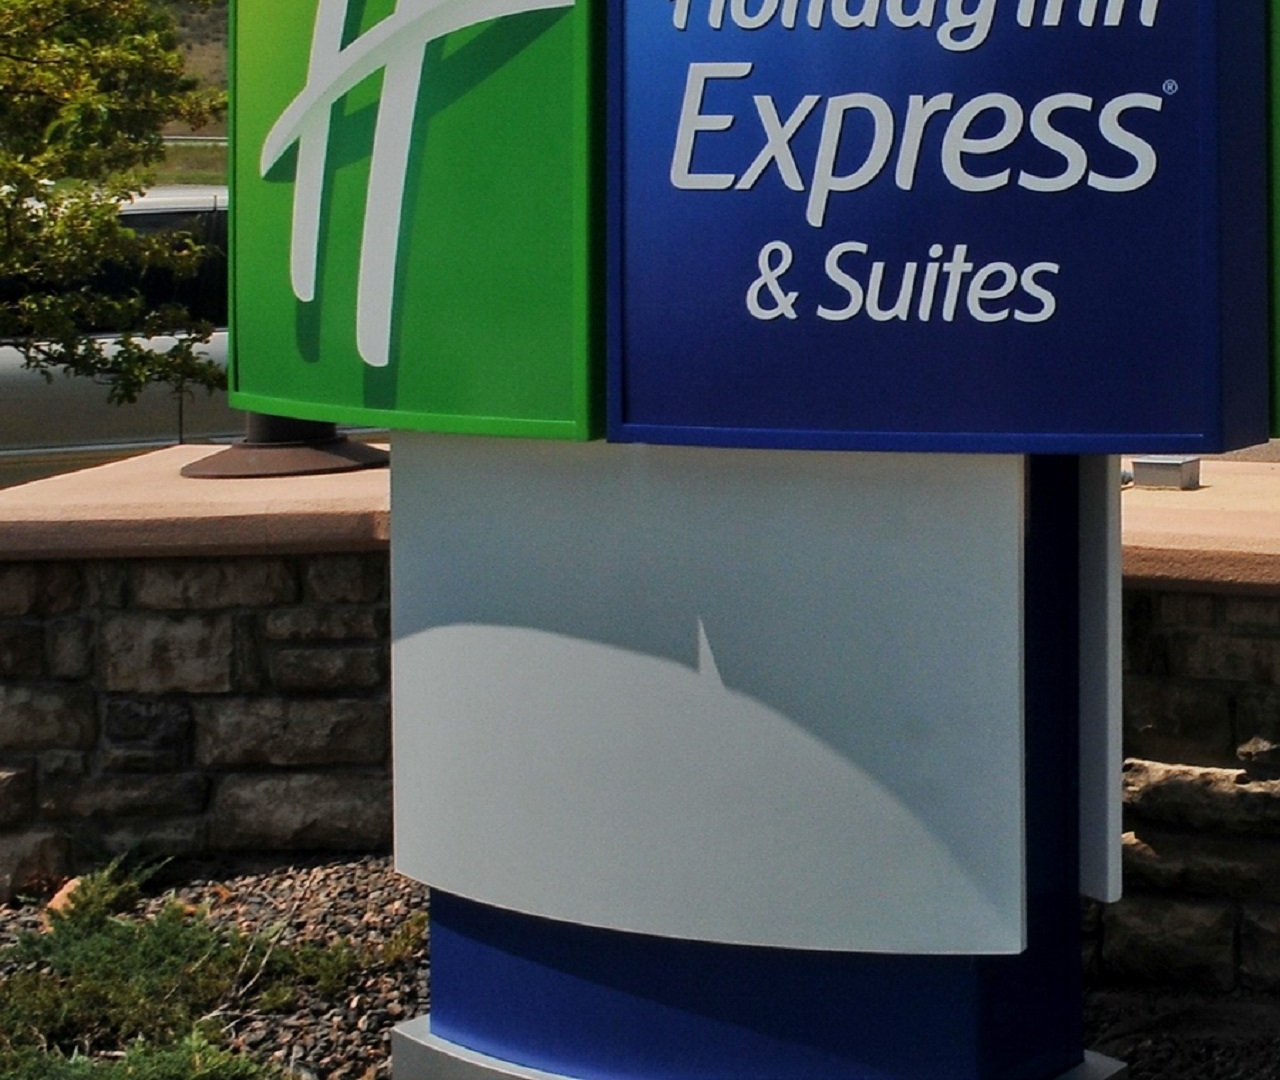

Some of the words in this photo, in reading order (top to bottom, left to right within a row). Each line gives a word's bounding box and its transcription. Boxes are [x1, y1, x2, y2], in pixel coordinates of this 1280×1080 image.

[670, 62, 1163, 228] Express
[746, 240, 799, 320] &
[816, 241, 1060, 323] Suites
